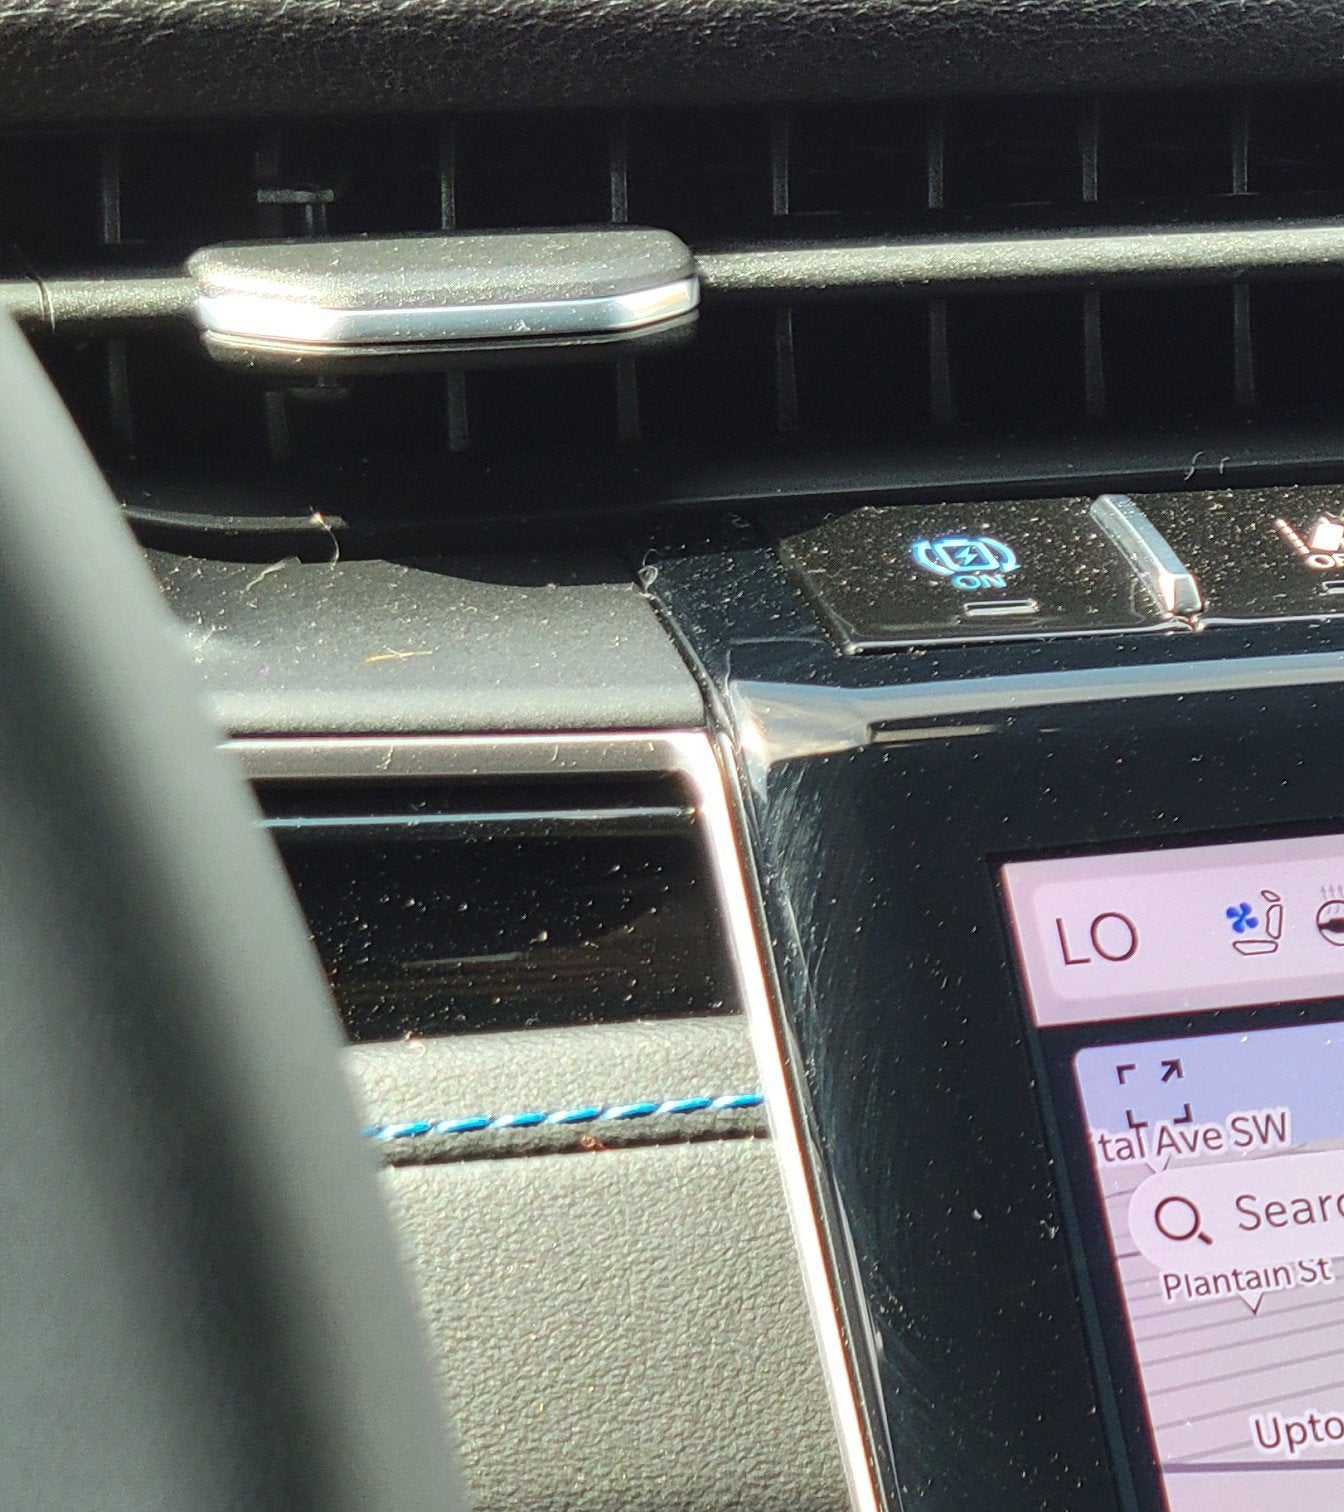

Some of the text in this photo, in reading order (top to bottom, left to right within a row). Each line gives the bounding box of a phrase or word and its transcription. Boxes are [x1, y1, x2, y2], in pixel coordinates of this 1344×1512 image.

[951, 573, 1007, 591] ON
[1055, 910, 1139, 966] LO
[1155, 1124, 1224, 1157] Ave
[1231, 1111, 1289, 1149] SW
[1162, 1258, 1332, 1300] Plantain St
